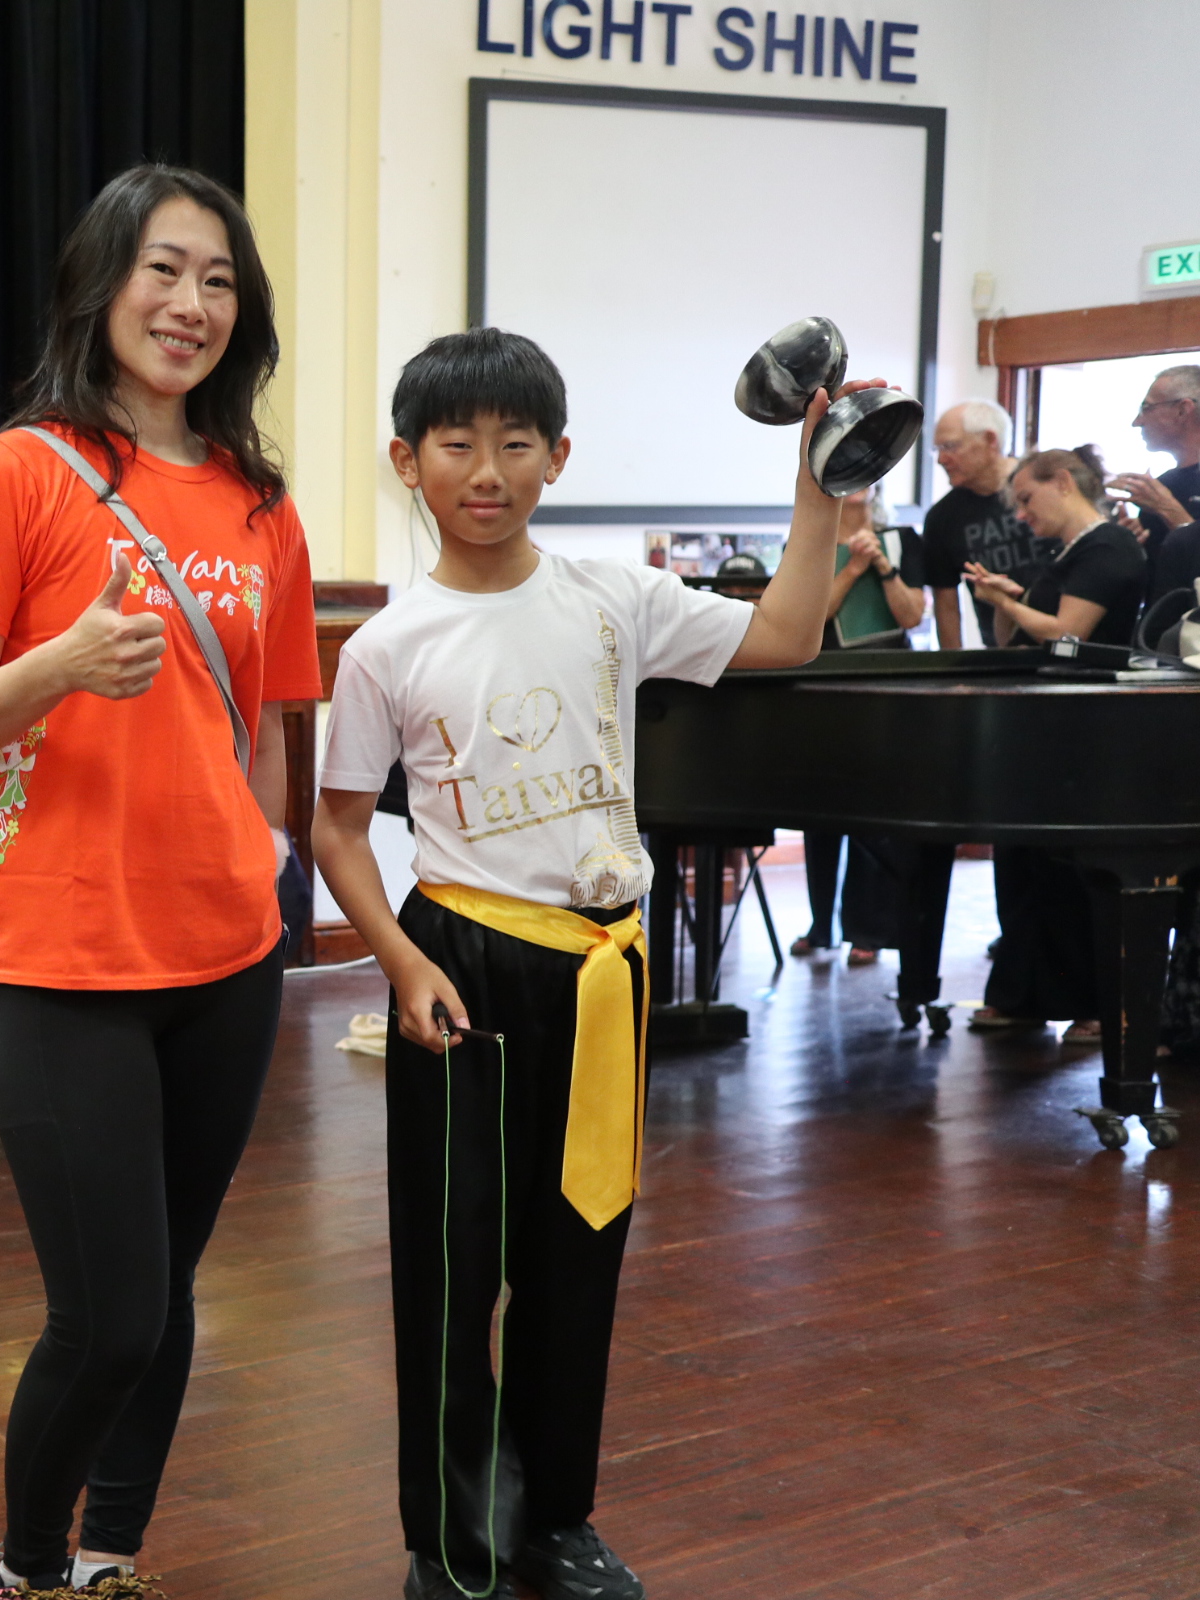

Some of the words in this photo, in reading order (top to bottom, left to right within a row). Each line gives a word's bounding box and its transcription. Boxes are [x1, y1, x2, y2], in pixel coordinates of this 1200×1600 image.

[477, 0, 692, 66] LIGHT
[713, 7, 919, 84] SHINE
[429, 716, 461, 768] I
